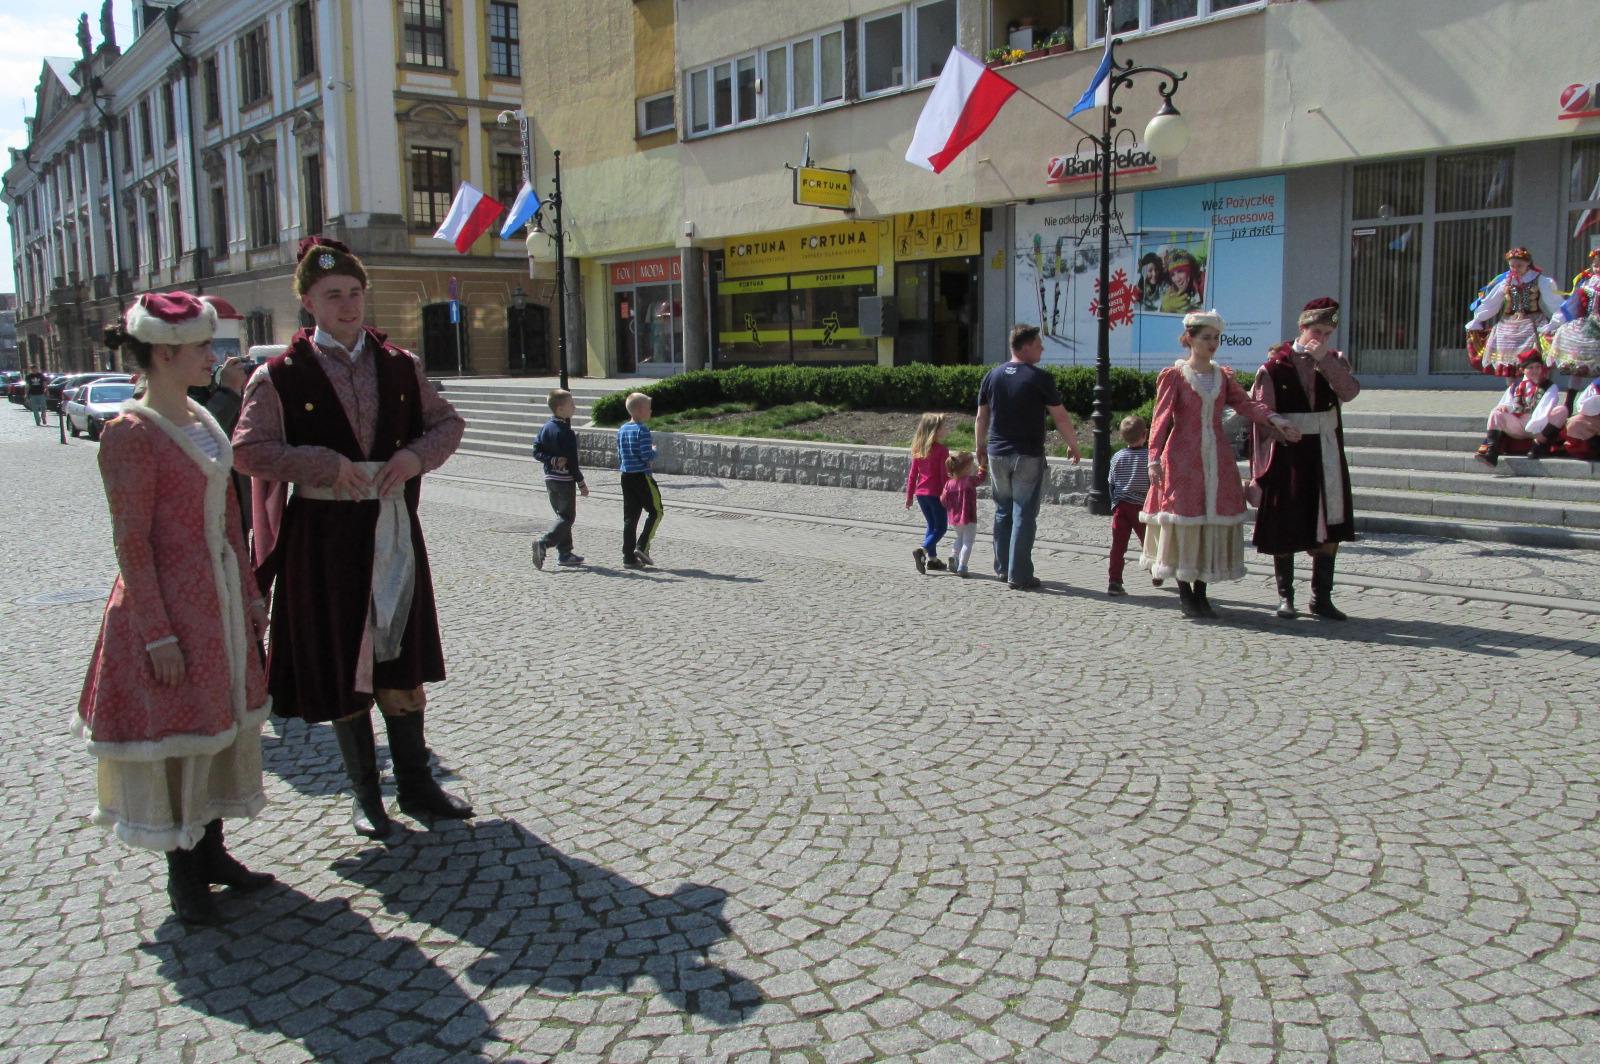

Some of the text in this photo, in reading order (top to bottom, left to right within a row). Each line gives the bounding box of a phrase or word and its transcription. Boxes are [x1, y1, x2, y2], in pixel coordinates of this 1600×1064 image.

[1065, 149, 1157, 176] Bank Pekao
[802, 179, 847, 190] FORTUNA
[1202, 193, 1275, 211] Weź Pożyczkę
[1044, 216, 1057, 227] Nie
[1212, 211, 1274, 225] Ekspresową
[801, 231, 867, 249] FORTUNA
[729, 240, 786, 257] FORTUNA
[616, 267, 631, 280] FOX
[640, 263, 665, 278] MODA
[816, 274, 845, 282] FORTUNA
[739, 280, 764, 288] FORTUNA
[1220, 334, 1253, 346] Pekao
